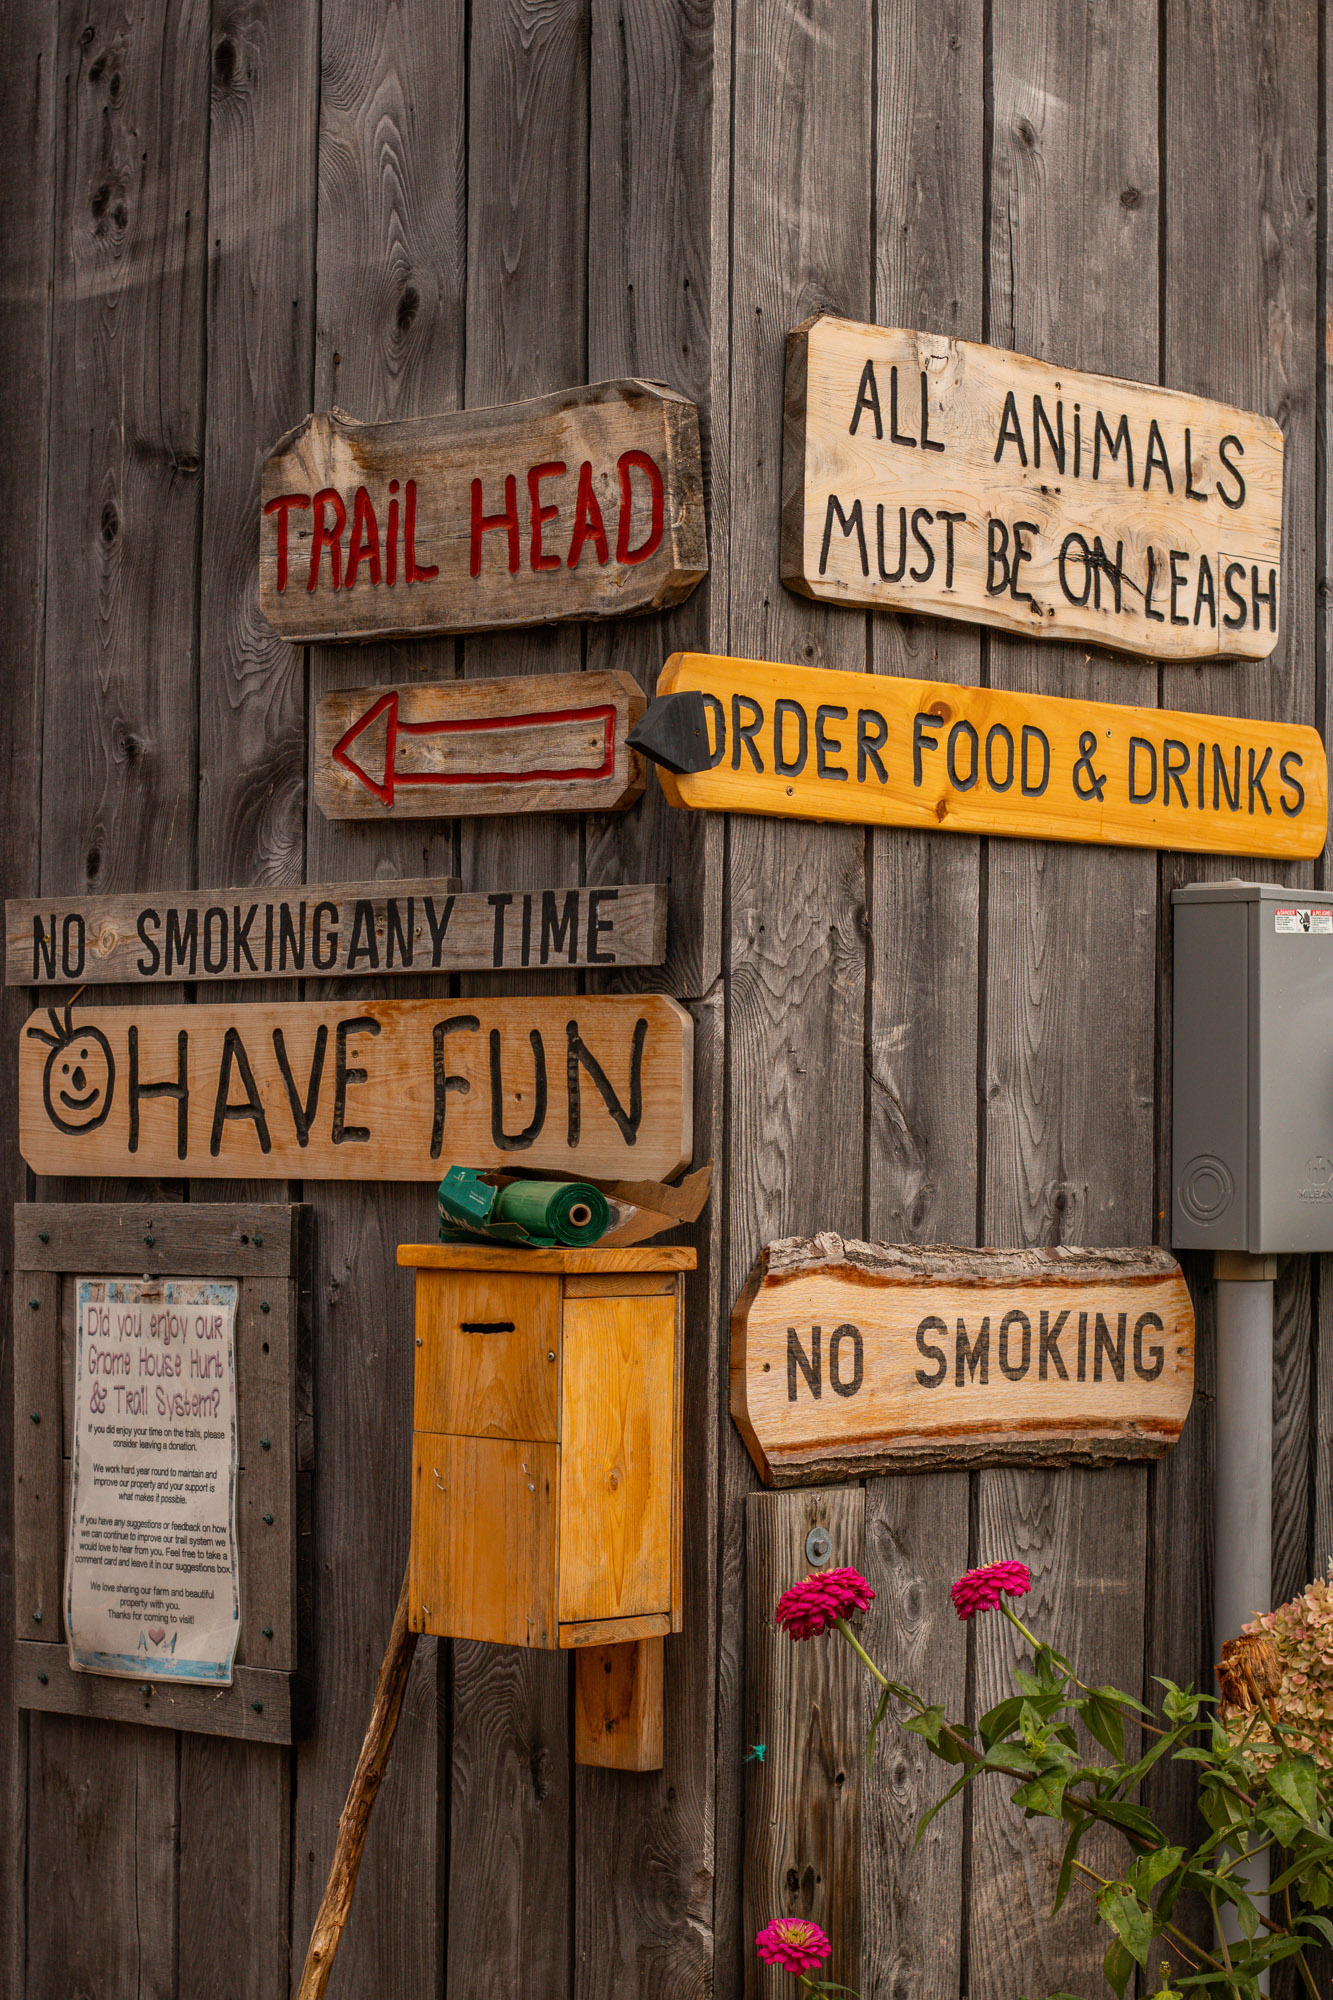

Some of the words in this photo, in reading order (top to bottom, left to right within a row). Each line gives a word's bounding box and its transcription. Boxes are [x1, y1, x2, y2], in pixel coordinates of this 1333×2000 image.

[849, 359, 945, 452] ALL
[470, 449, 664, 578] HEAD
[819, 493, 966, 588] MUST
[987, 518, 1041, 603] BE
[1058, 532, 1124, 613] ON
[1145, 545, 1277, 633] LEASH
[912, 712, 1050, 798] FOOD
[1072, 730, 1107, 803] &
[1128, 737, 1305, 818] DRINKS
[33, 913, 86, 980] NO
[136, 900, 338, 976] SMOKING
[346, 896, 456, 970] ANY
[488, 889, 619, 967] TIME
[128, 1016, 382, 1160] HAVE
[430, 1014, 649, 1160] FUN
[88, 1306, 110, 1338] Did
[118, 1314, 142, 1342] you
[150, 1309, 188, 1345] enjoy
[195, 1314, 223, 1340] our
[88, 1344, 131, 1375] Gnome
[139, 1346, 182, 1378] House
[190, 1348, 223, 1378] Hunt
[786, 1323, 864, 1402] NO
[915, 1309, 1164, 1389] SMOKING
[90, 1380, 107, 1414] &
[114, 1384, 148, 1415] Trail
[156, 1384, 221, 1422] System?
[90, 1581, 101, 1591] We
[102, 1582, 115, 1592] love
[116, 1584, 139, 1596] sharing
[153, 1586, 169, 1595] farm
[171, 1588, 183, 1597] and
[185, 1588, 214, 1599] beautiful
[108, 1608, 131, 1619] Thanks
[132, 1611, 142, 1620] for
[144, 1613, 168, 1624] coming
[170, 1614, 177, 1623] to
[179, 1614, 194, 1624] visit!
[120, 1598, 148, 1610] property
[150, 1600, 164, 1608] with
[165, 1602, 180, 1611] you.
